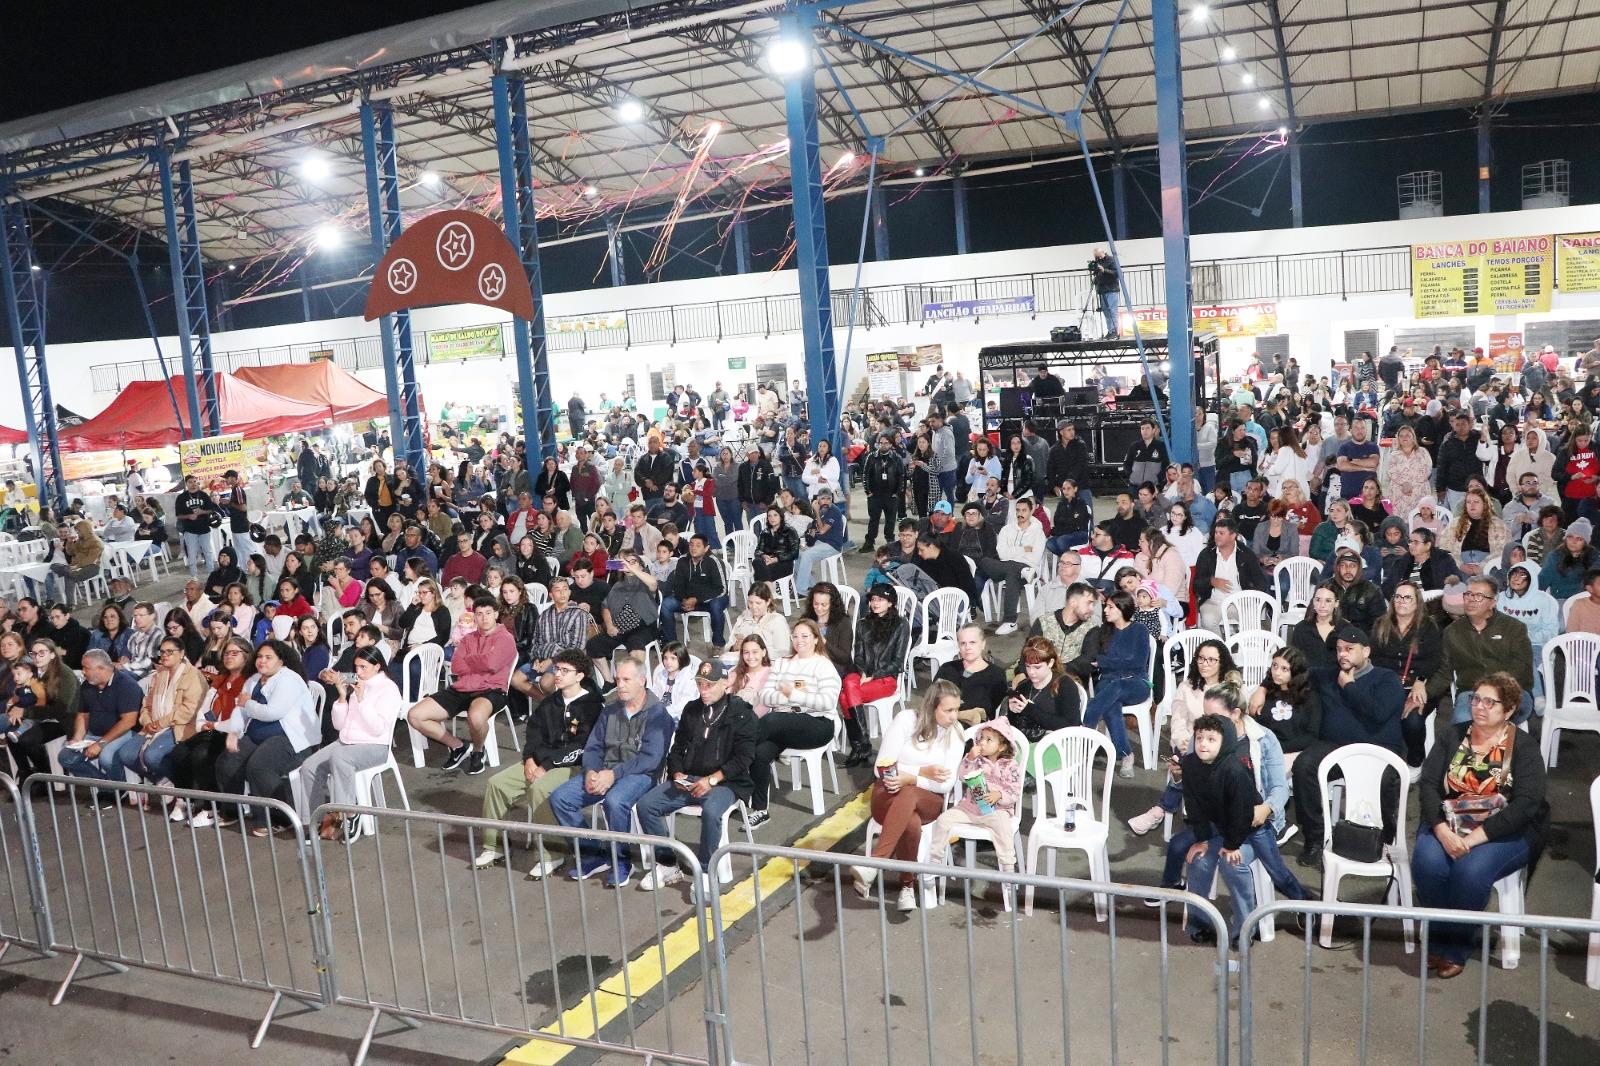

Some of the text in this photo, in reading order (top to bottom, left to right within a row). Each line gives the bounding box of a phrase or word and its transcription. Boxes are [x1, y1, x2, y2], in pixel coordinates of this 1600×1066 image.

[1416, 238, 1548, 259] BANCA DO BAIANO
[1432, 261, 1466, 269] LANCHES
[1200, 308, 1217, 317] DO
[200, 440, 242, 456] NOVIDADES
